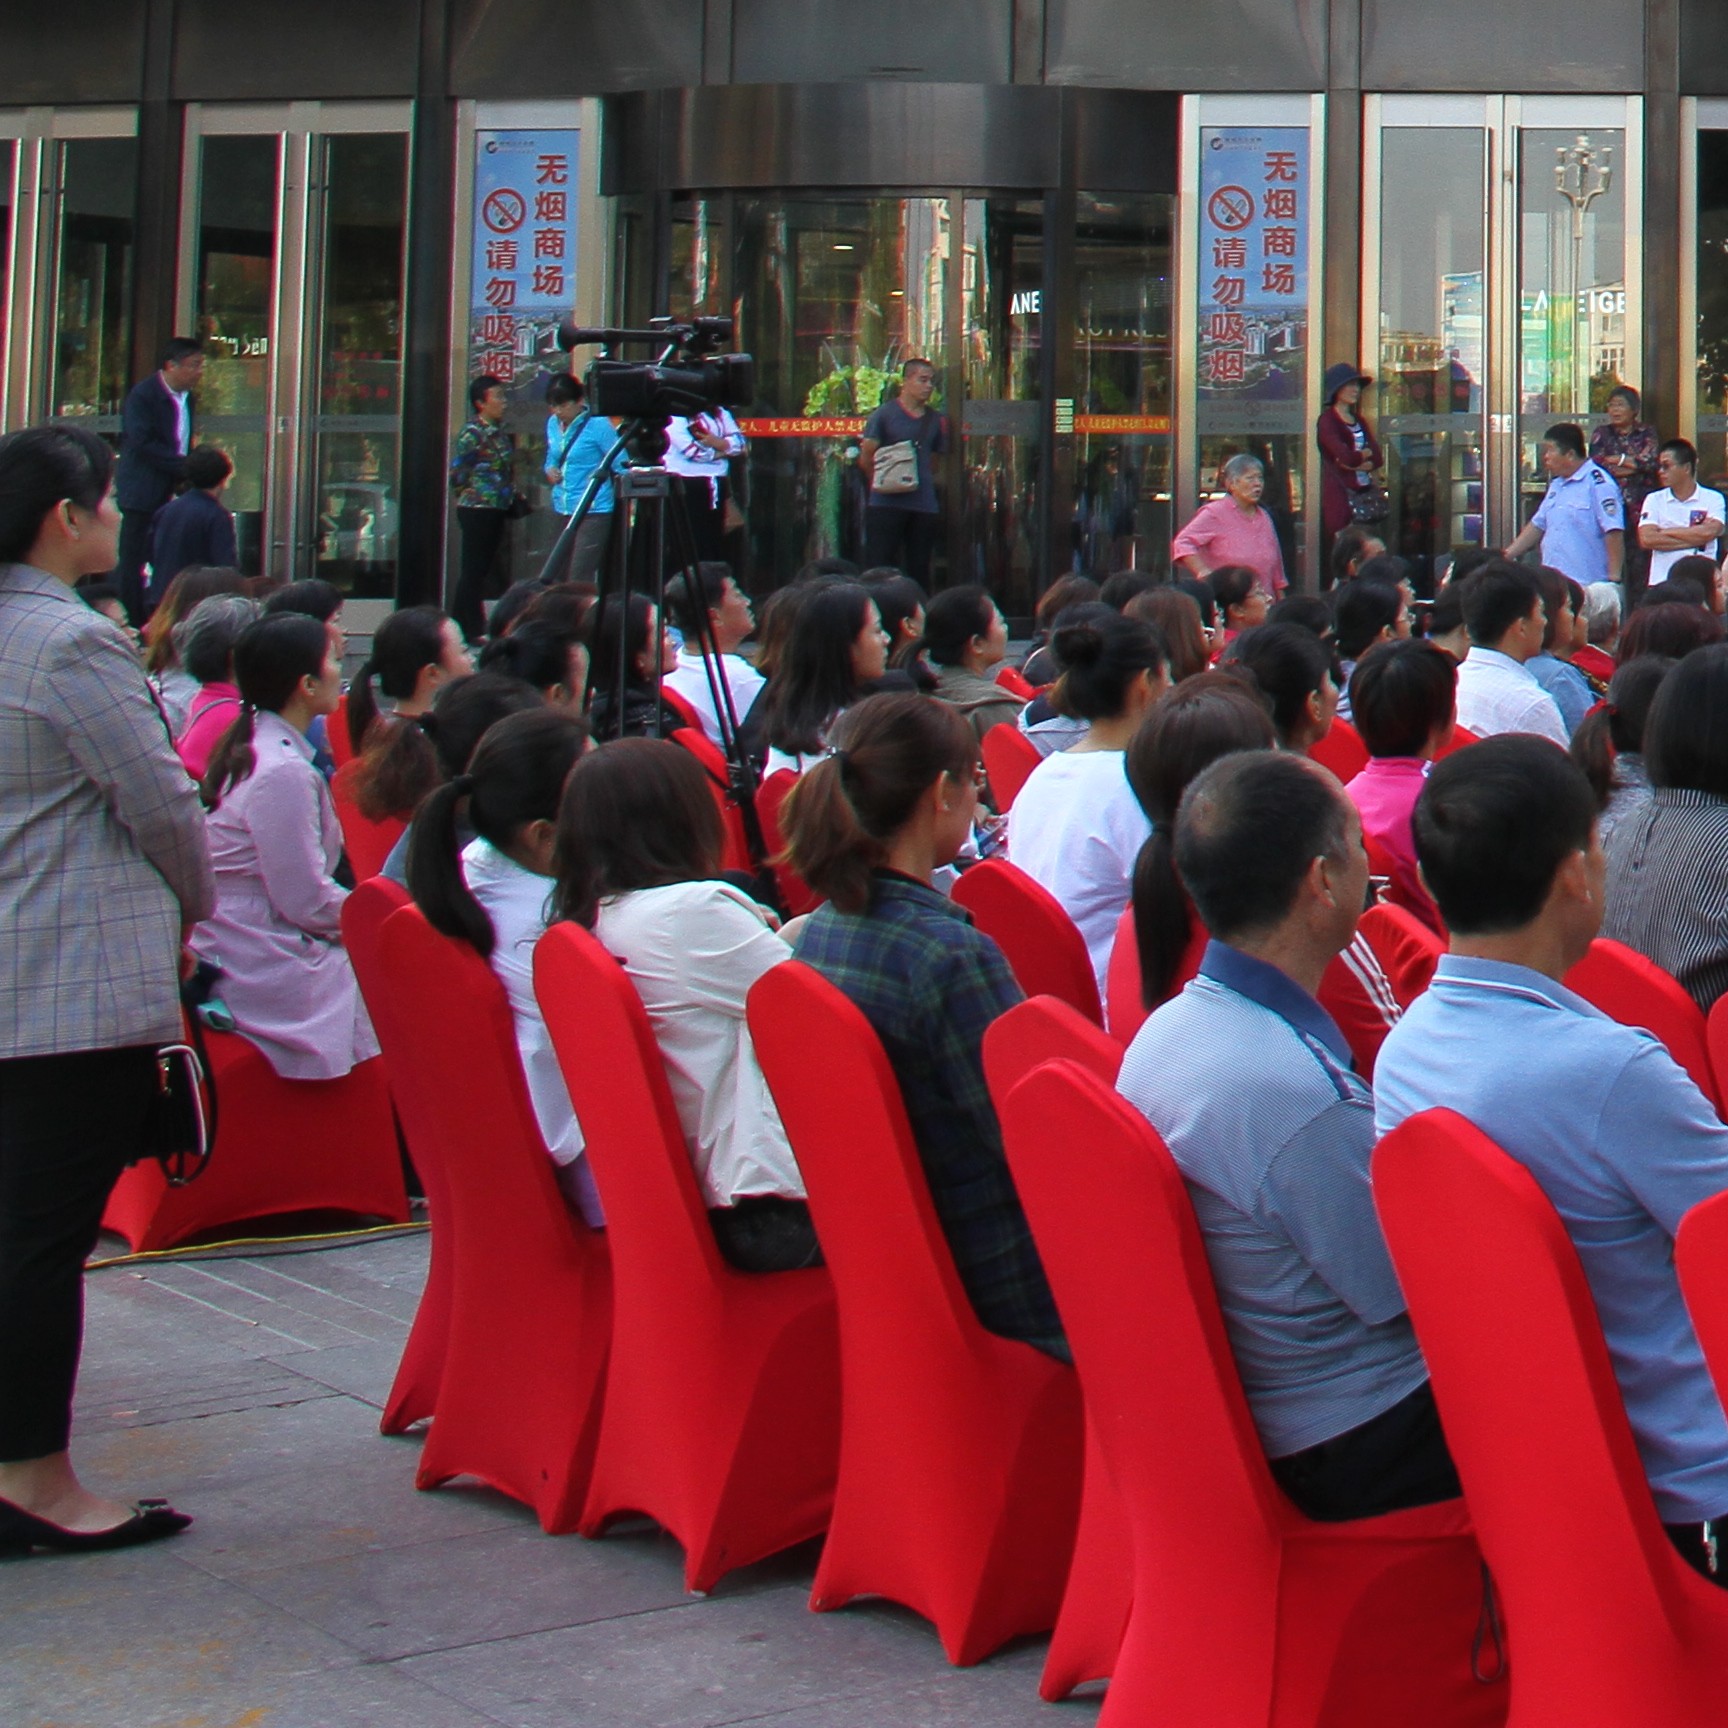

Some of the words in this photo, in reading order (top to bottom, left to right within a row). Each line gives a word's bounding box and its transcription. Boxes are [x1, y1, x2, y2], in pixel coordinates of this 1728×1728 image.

[532, 154, 568, 296] 无烟商场
[1261, 151, 1297, 294] 无烟商场
[481, 239, 519, 382] 请勿吸烟
[1210, 237, 1246, 381] 请勿吸烟
[1521, 290, 1625, 313] LAEIGE
